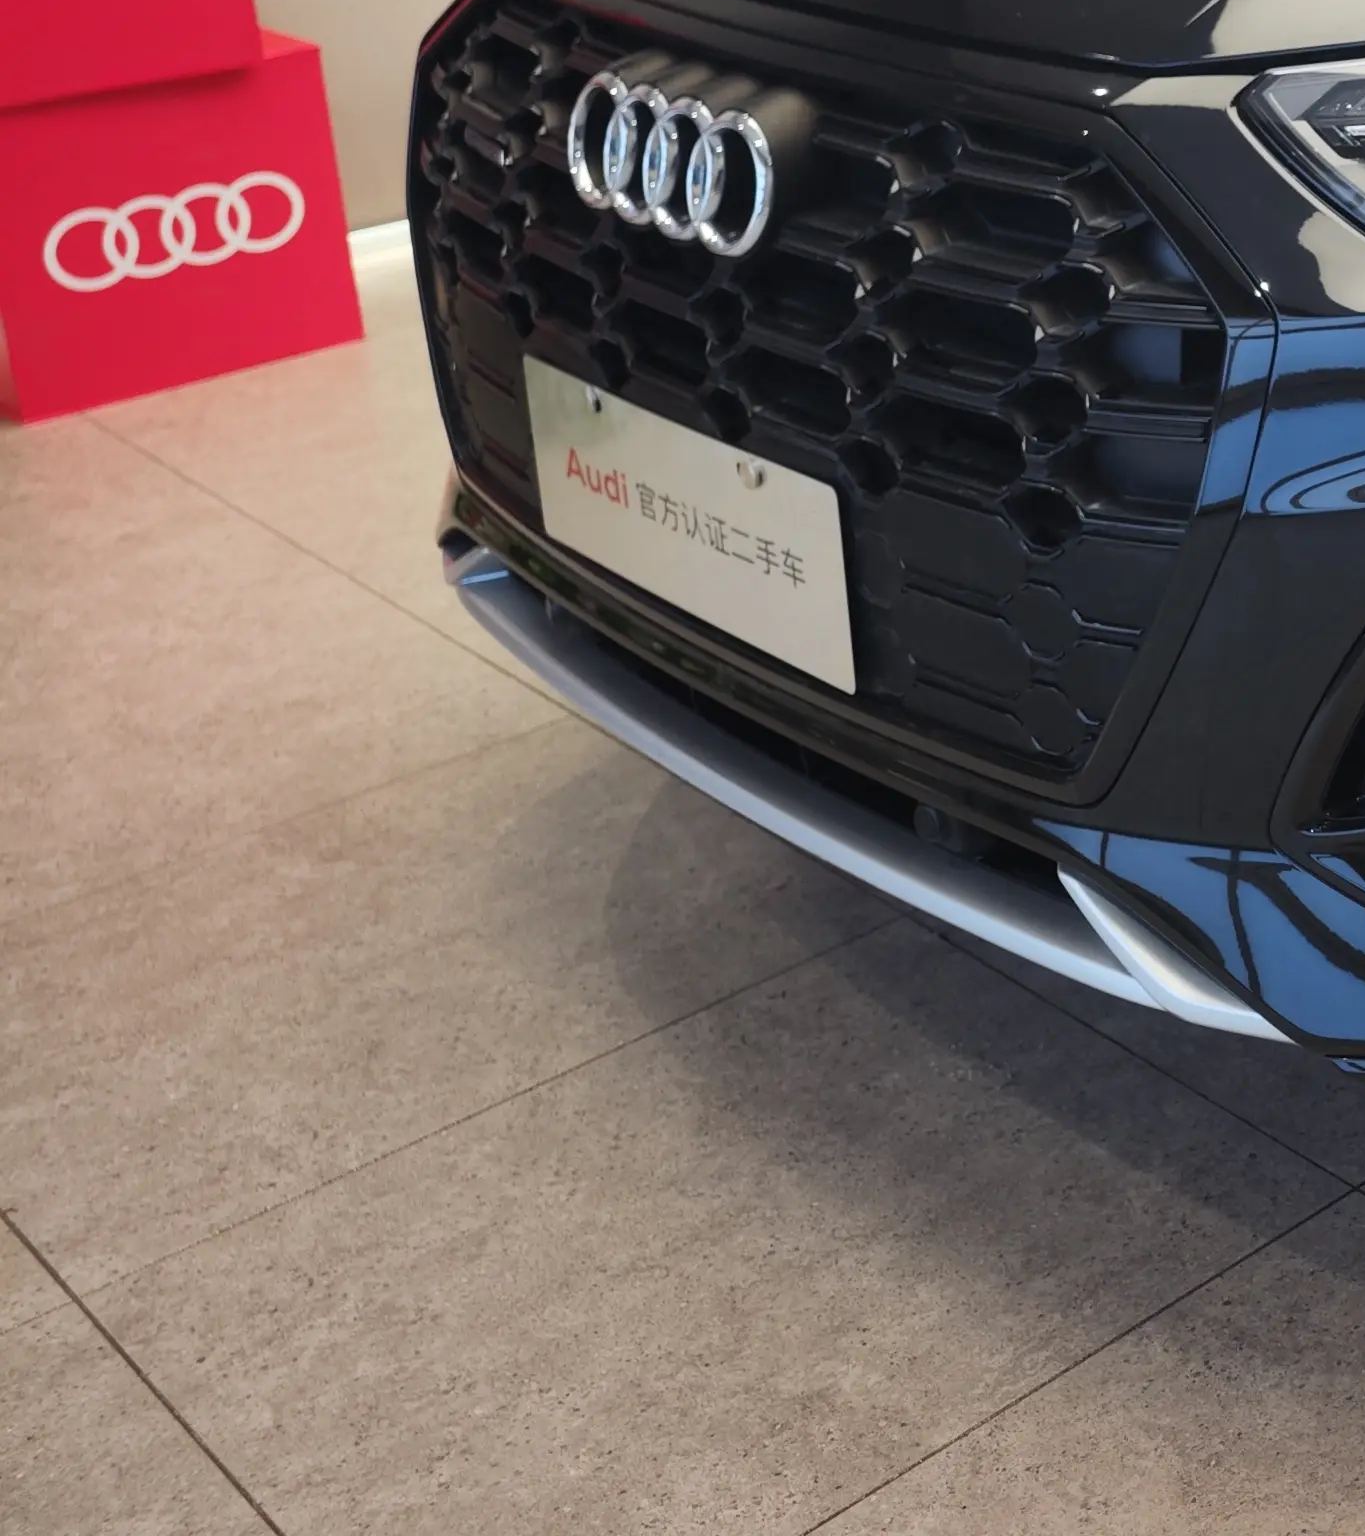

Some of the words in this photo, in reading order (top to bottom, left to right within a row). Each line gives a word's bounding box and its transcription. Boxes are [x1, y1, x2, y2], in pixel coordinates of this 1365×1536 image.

[566, 446, 630, 509] Audi
[635, 480, 806, 589] 官方认证二手车
